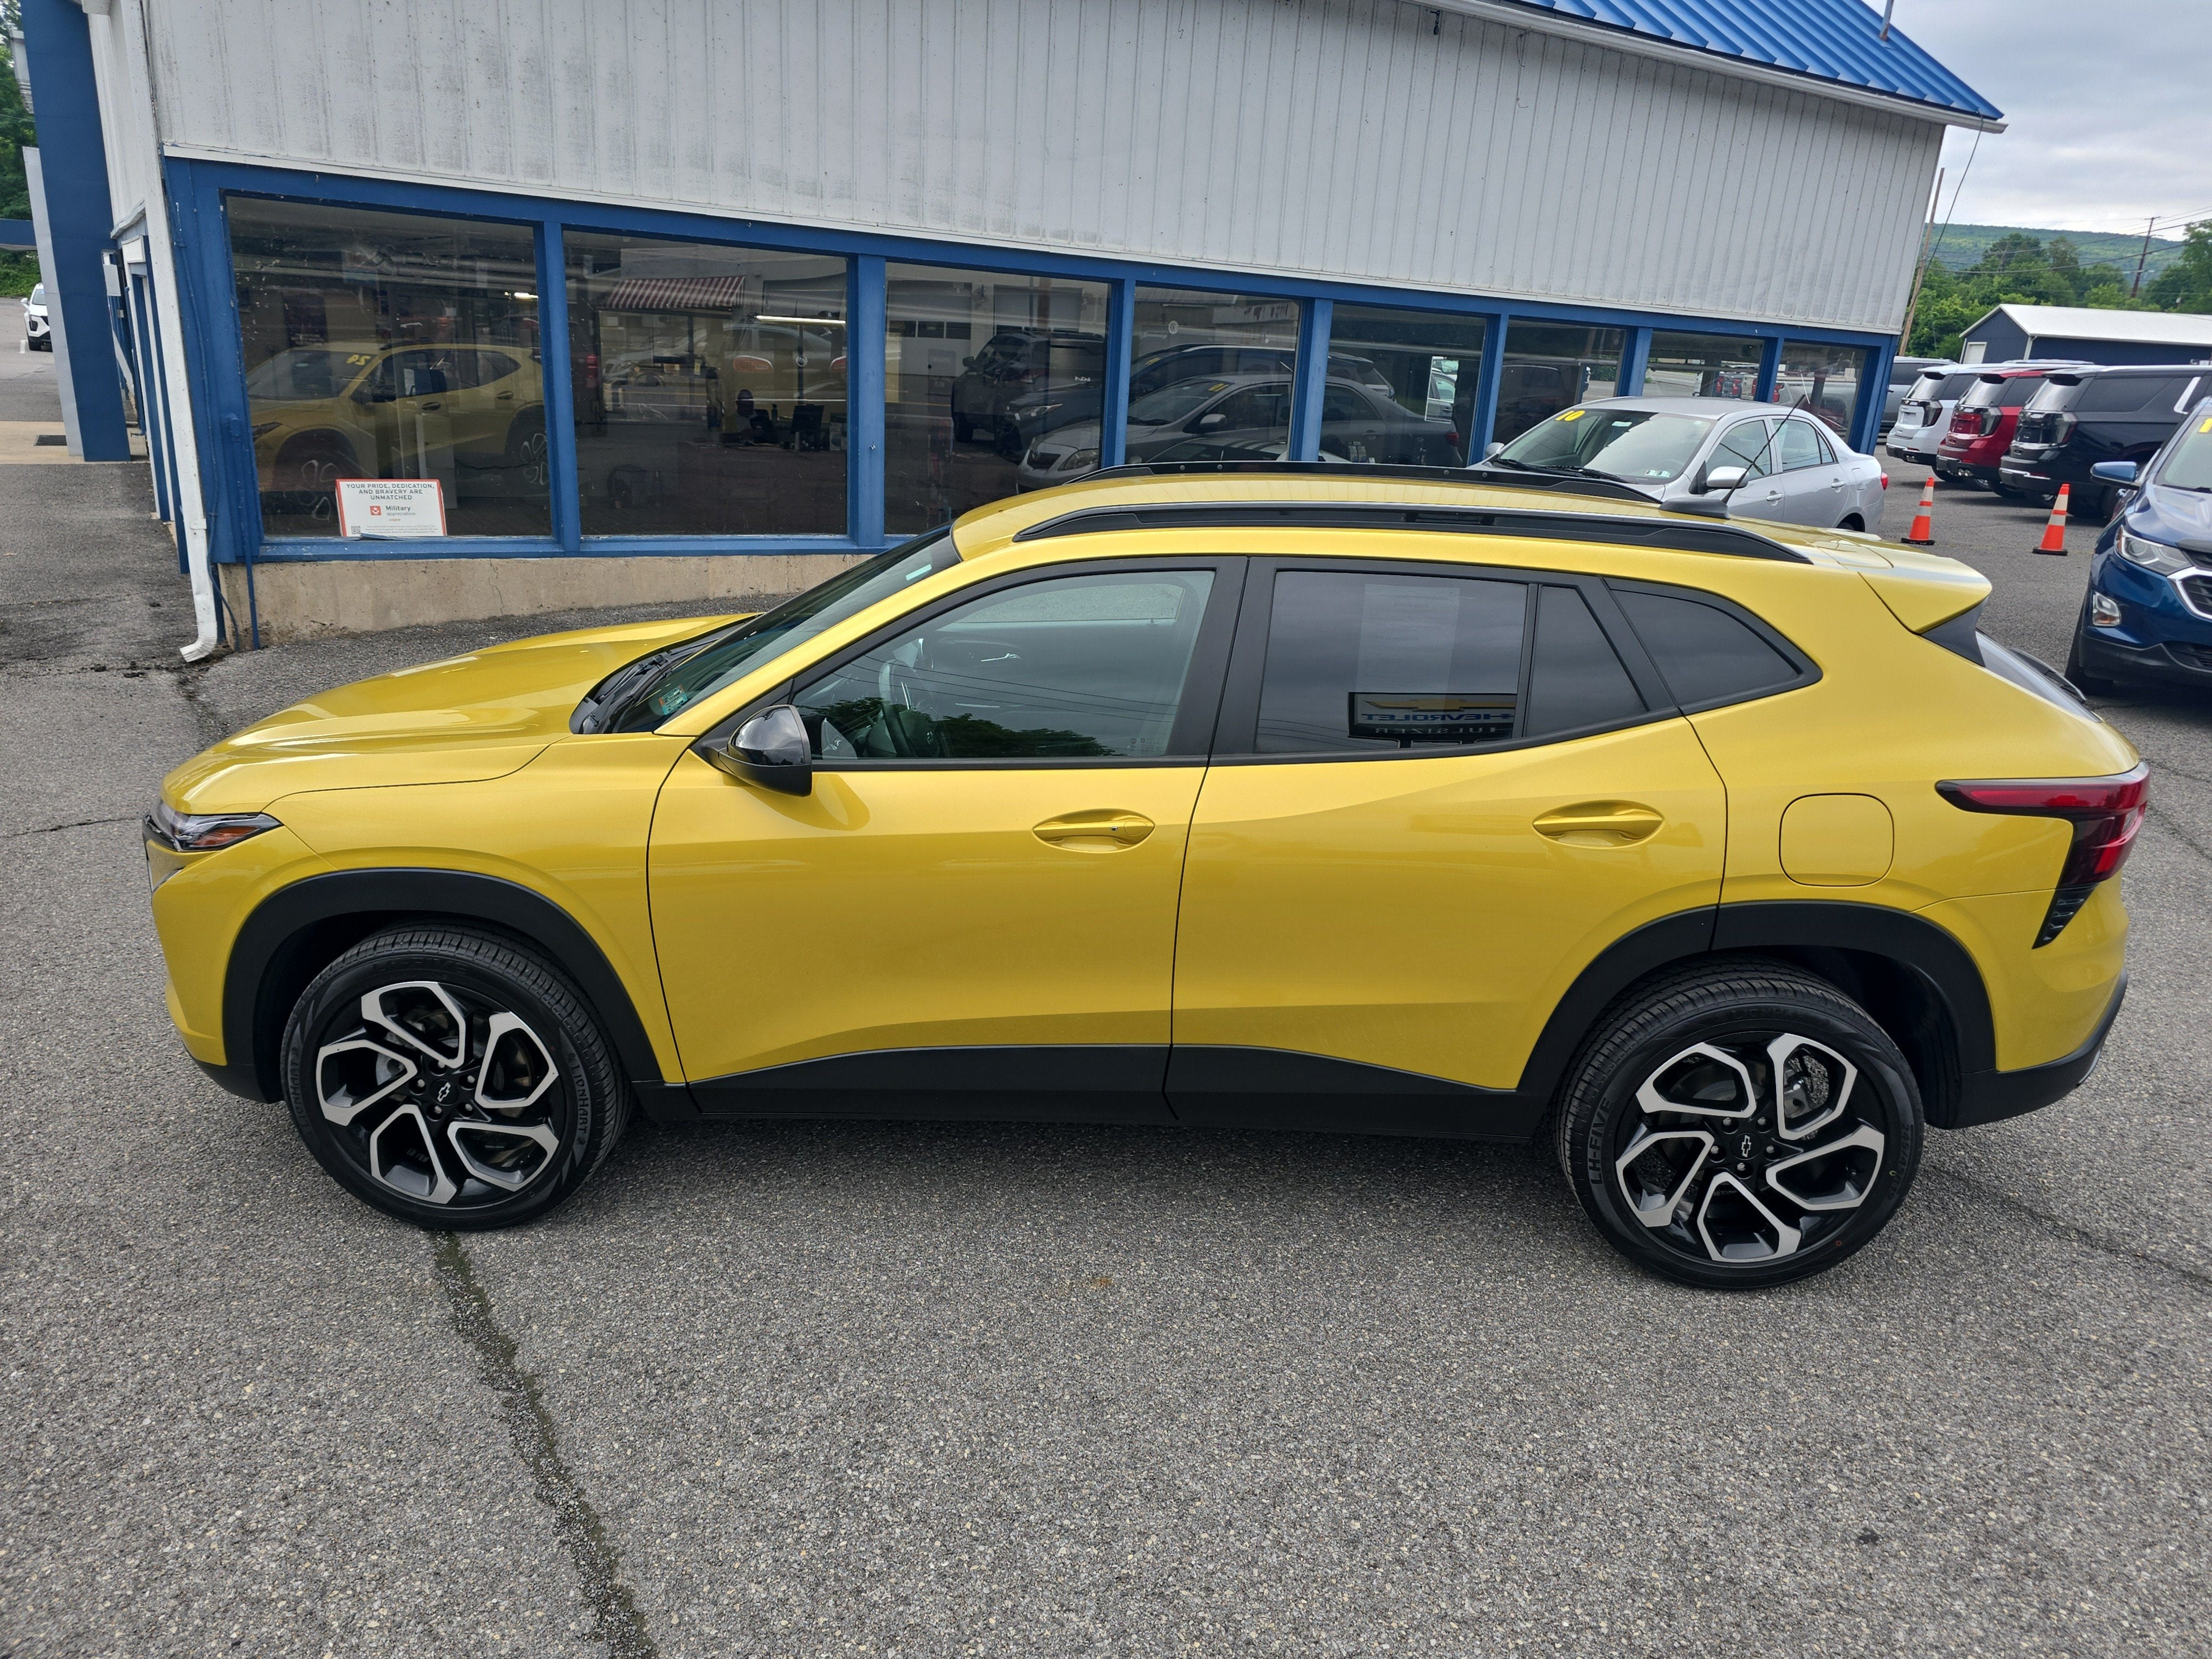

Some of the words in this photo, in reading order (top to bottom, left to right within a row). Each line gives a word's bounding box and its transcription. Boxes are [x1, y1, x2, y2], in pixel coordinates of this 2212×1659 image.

[1555, 410, 1585, 421] 10
[571, 1064, 589, 1134] LIONHART
[1589, 1097, 1613, 1185] LH-FIVE
